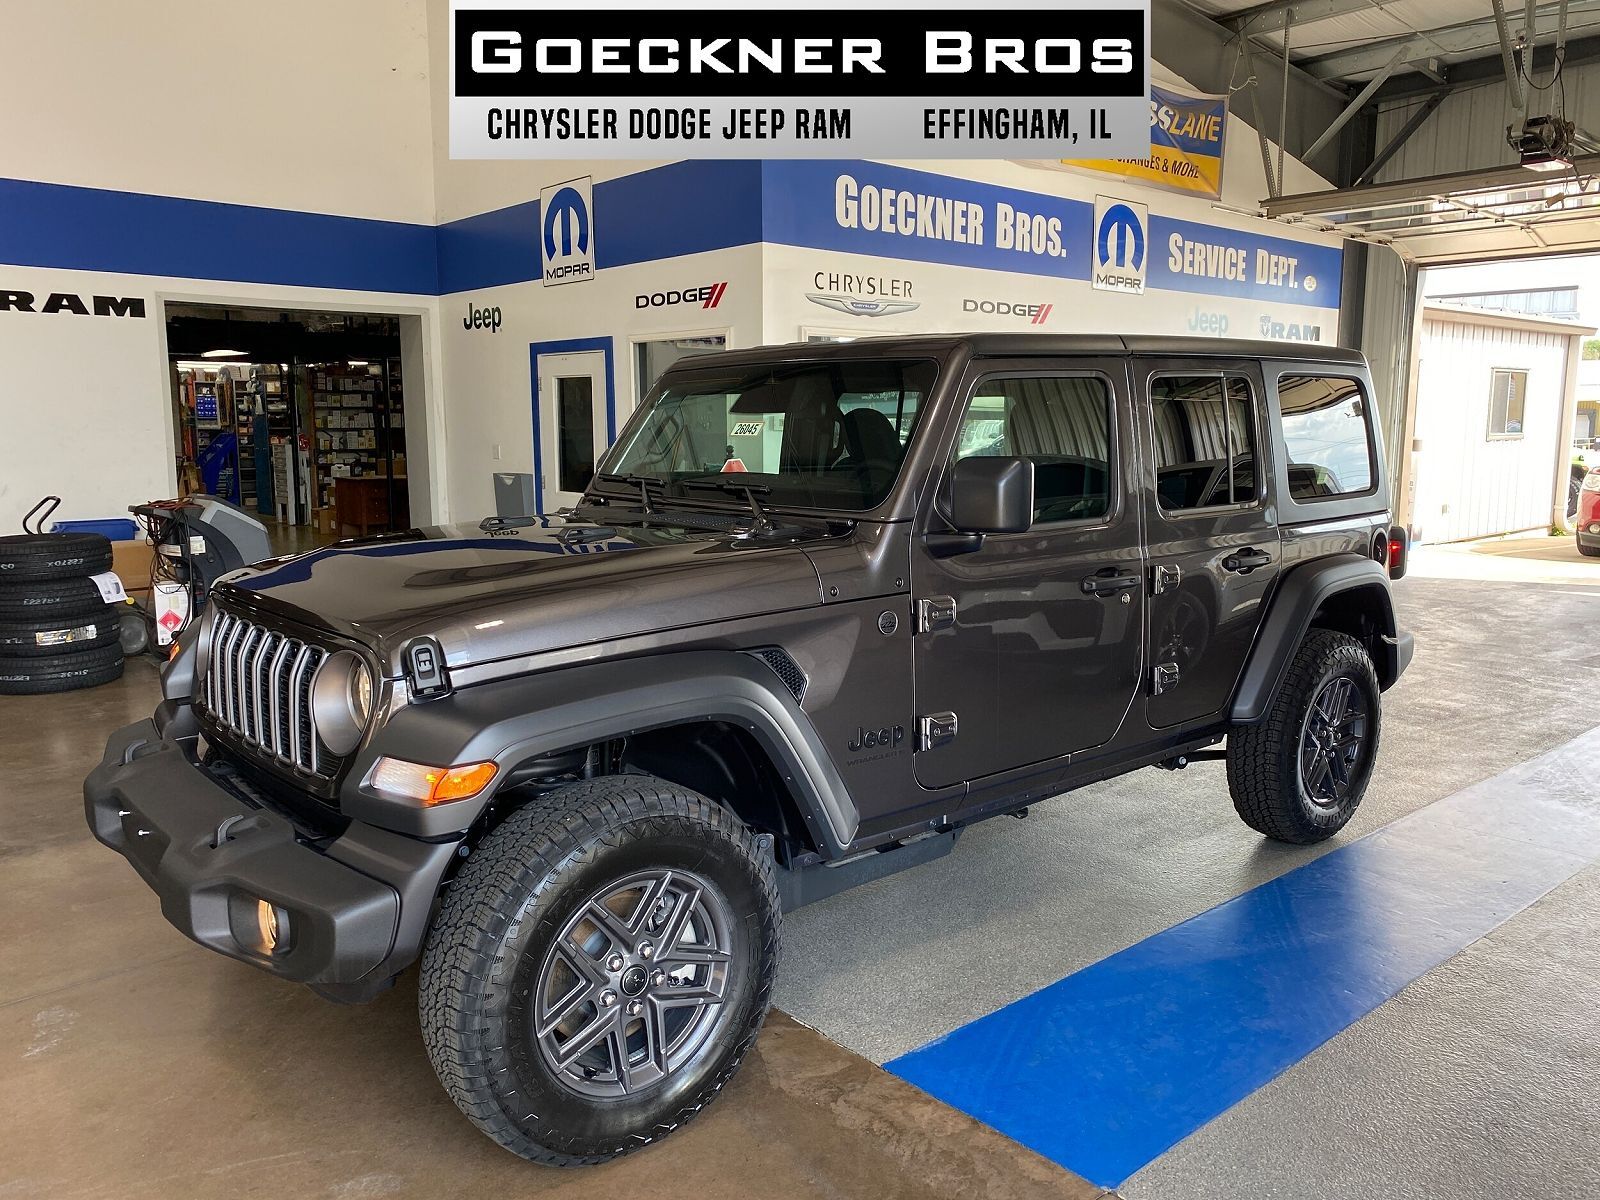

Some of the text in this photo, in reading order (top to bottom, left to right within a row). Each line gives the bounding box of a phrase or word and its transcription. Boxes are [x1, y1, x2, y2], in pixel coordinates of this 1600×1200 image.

[1162, 158, 1169, 173] &
[1171, 161, 1199, 178] MORE
[835, 174, 1067, 258] GOECKNER BROS.
[546, 262, 590, 280] MOPAR
[1168, 232, 1299, 289] SERVICE DEPT.
[814, 271, 913, 298] CHRYSLER
[1096, 273, 1142, 289] MOPAR
[0, 289, 146, 319] RAM
[635, 286, 713, 309] DODGE
[962, 299, 1041, 317] DODGE
[463, 302, 502, 333] Jeep
[1187, 307, 1229, 337] Jeep
[1270, 322, 1321, 342] RAM
[734, 423, 760, 435] 26045
[847, 725, 904, 752] Jeep
